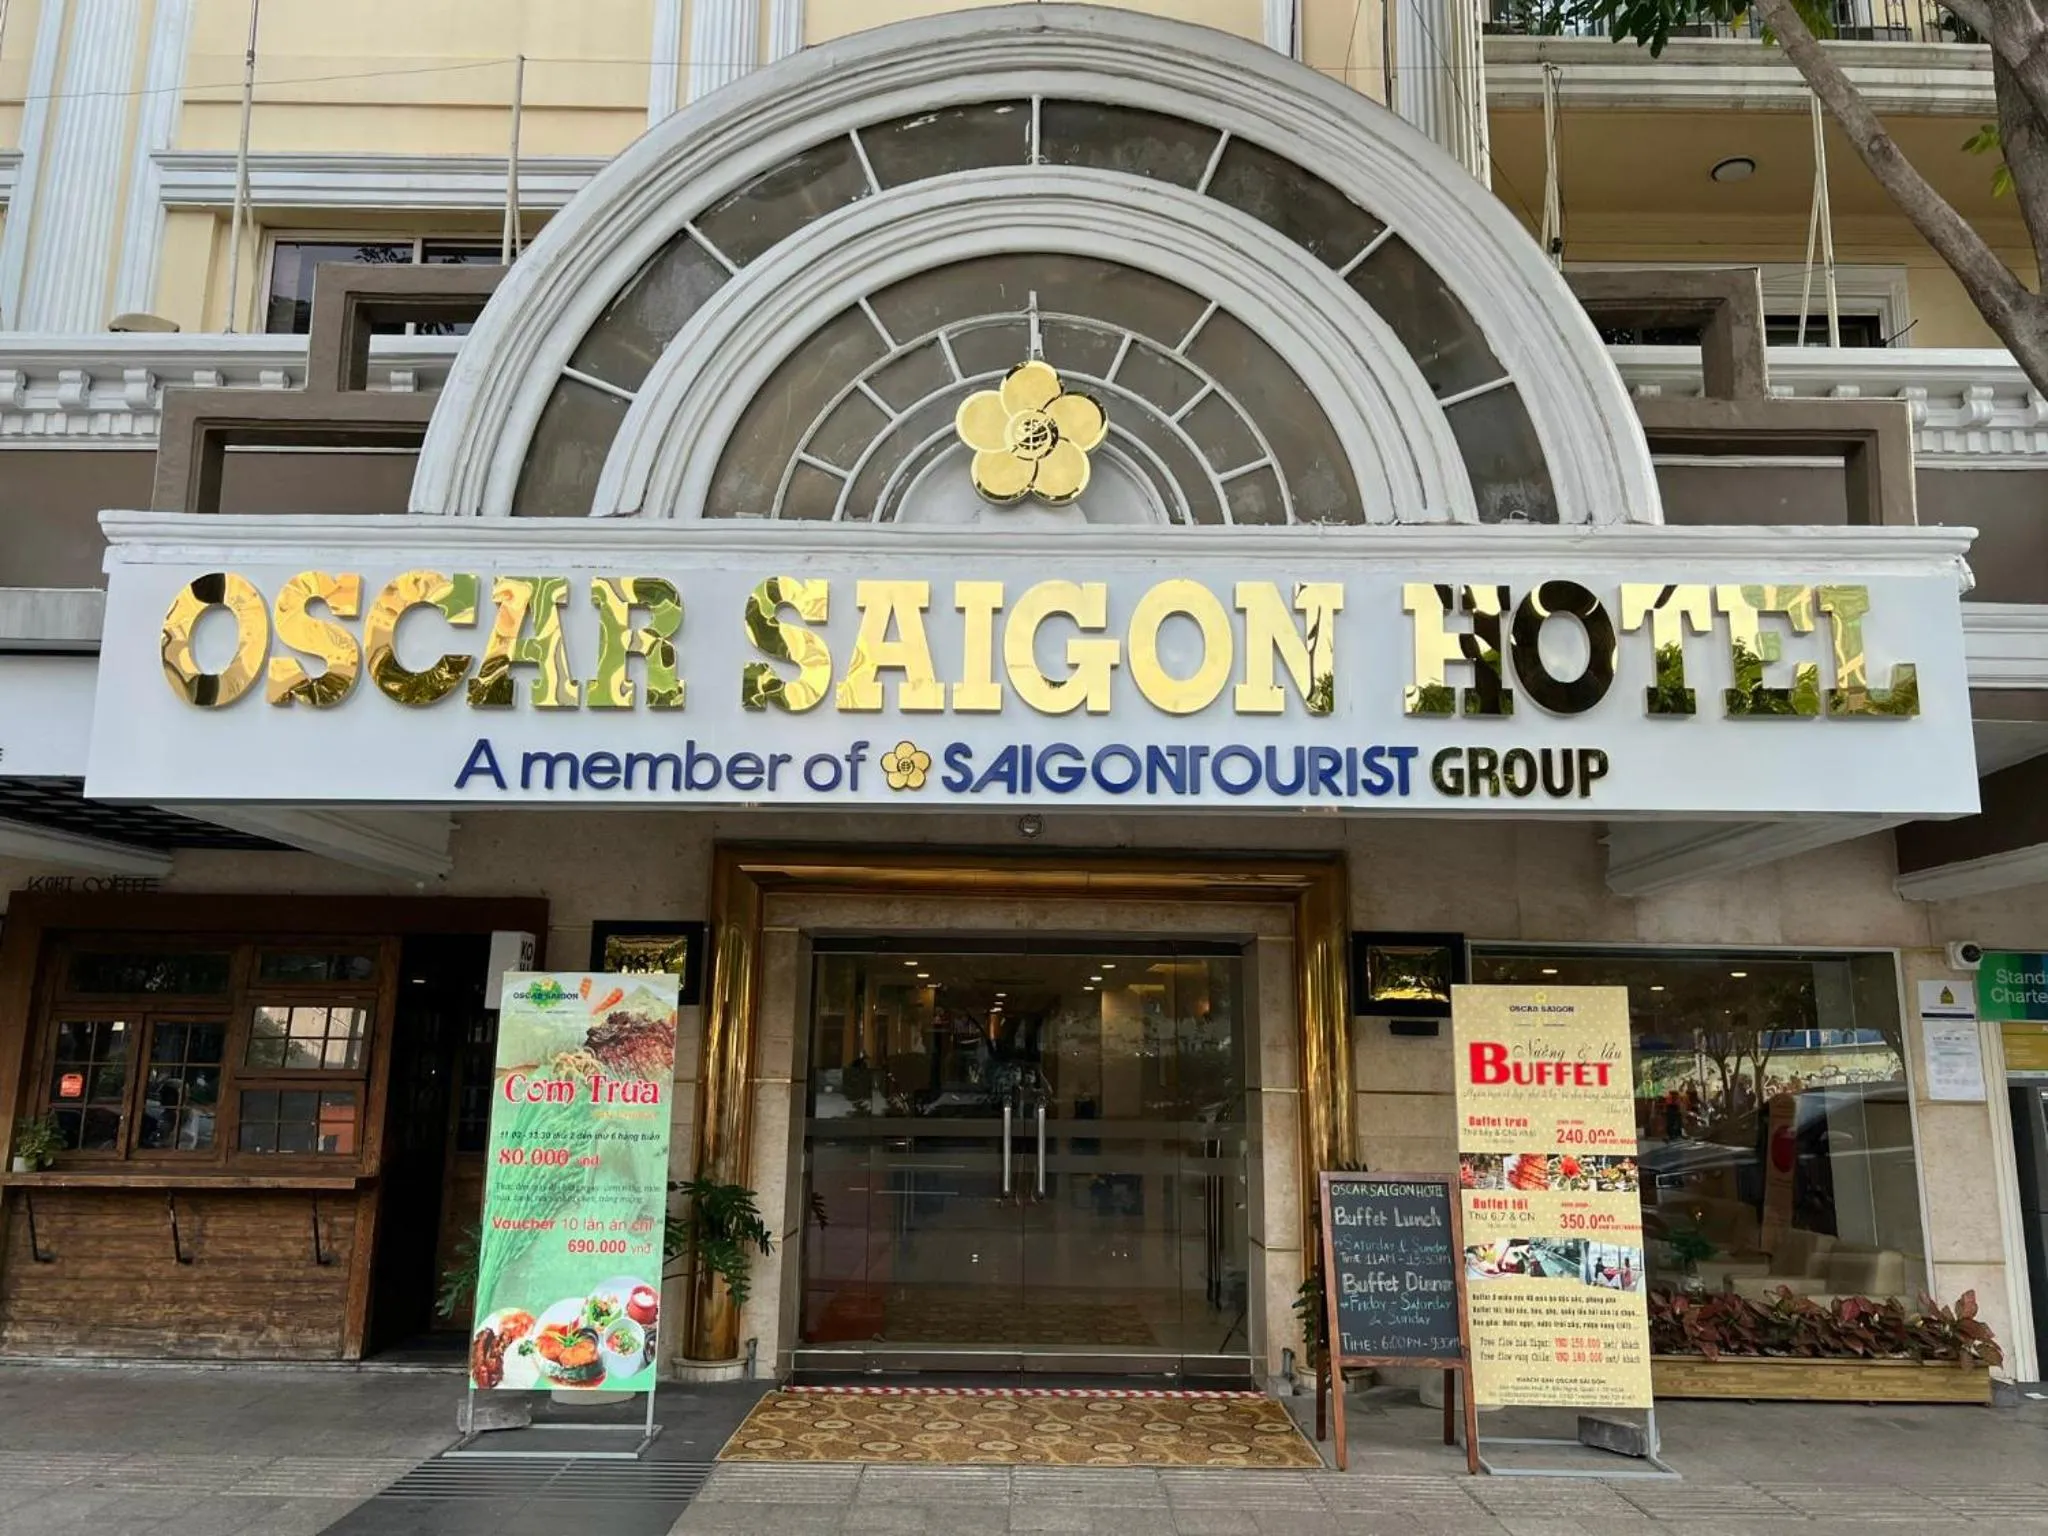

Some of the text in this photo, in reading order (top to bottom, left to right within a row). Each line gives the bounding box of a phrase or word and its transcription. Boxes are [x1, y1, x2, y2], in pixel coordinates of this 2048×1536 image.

[161, 569, 1922, 719] OSCAR SAIGON HOTEL
[454, 738, 1610, 799] A member of SAIGONTOURIST GROUP
[1996, 968, 2048, 985] Stand
[498, 1147, 570, 1168] 80.000
[1331, 1183, 1369, 1197] OSCAR
[1369, 1183, 1415, 1198] SAIGON
[492, 1216, 556, 1231] Voucher
[562, 1218, 579, 1232] 10
[1334, 1205, 1443, 1228] Buffet Lunch
[567, 1239, 628, 1254] 690.000
[1342, 1271, 1400, 1294] Buffet
